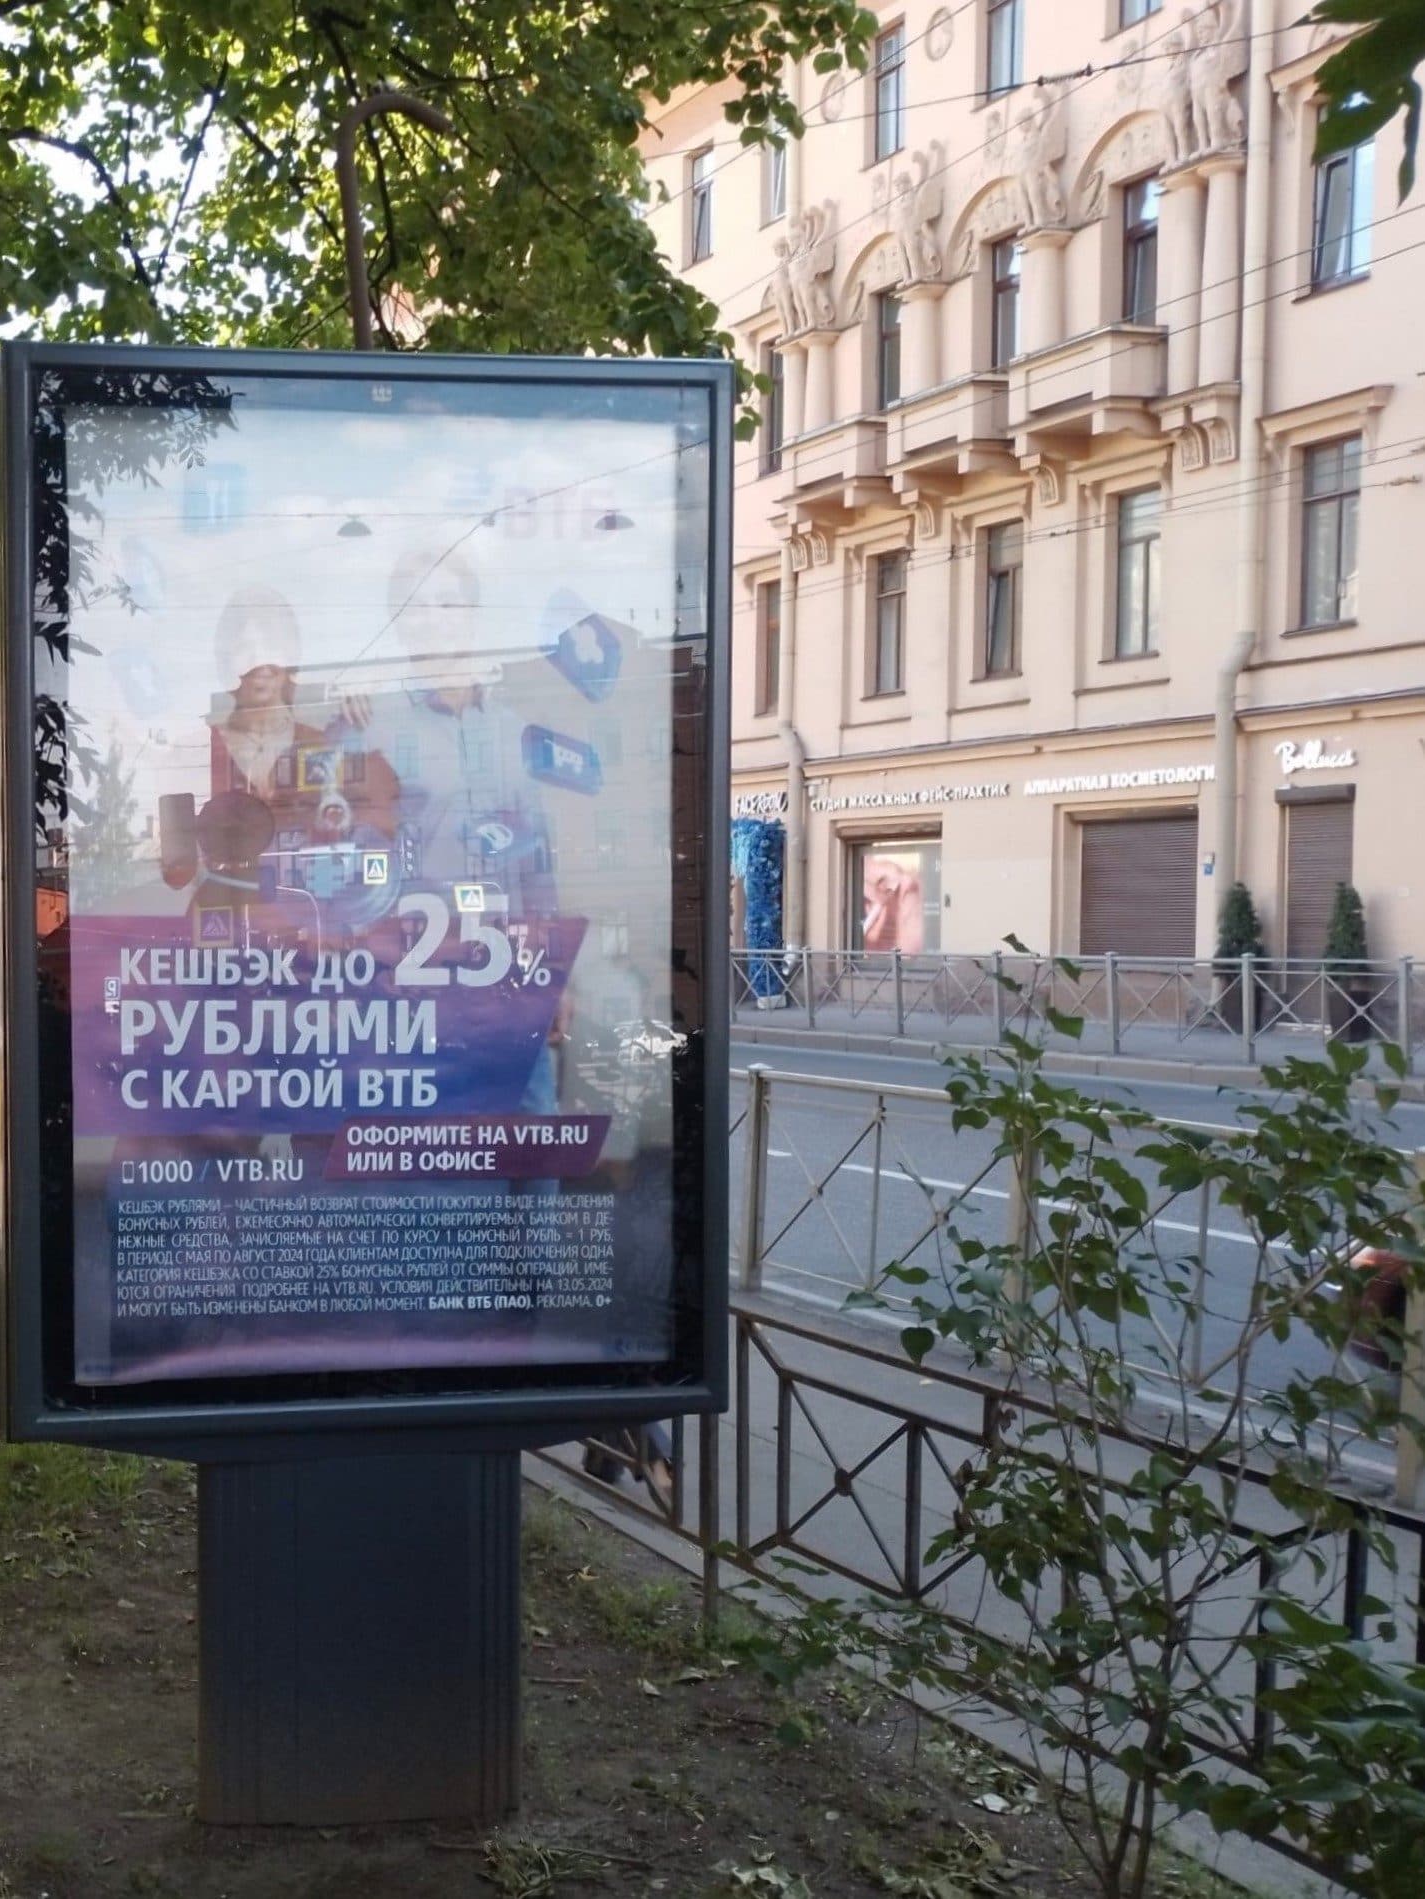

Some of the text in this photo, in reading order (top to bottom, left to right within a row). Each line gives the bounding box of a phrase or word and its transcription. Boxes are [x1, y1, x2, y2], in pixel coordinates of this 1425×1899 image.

[1024, 764, 1216, 795] АППАРАТНАЯ КОСМЕТОЛОГИ
[810, 784, 1009, 812] СТУДИЯ МАССАЖНЫХ ФЕЙС-ПРАКТИК
[120, 893, 551, 993] КЕШБЭК ДО 25%
[120, 1000, 437, 1056] РУБЛЯМИ
[121, 1059, 438, 1109] С КАРТОЙ ВТБ
[347, 1125, 589, 1146] ОФОРМИТЕ НА VTB.RU
[138, 1160, 193, 1184] 1000
[216, 1158, 304, 1181] VTB.RU
[347, 1151, 496, 1172] ИЛИ В ОФИСЕ
[118, 1200, 165, 1214] КЕШБЭК
[168, 1199, 221, 1213] РУБЛЯМИ
[236, 1195, 307, 1212] ЧАСТИЧНЫЙ
[310, 1197, 359, 1211] ВОЗВРАТ
[362, 1196, 433, 1209] СТОИМОСТИ
[436, 1195, 492, 1209] ПОКУПКИ
[495, 1195, 503, 1208] В
[505, 1195, 535, 1209] ВИДЕ
[538, 1194, 614, 1208] НАЧИСЛЕНИЯ
[118, 1217, 180, 1232] БОНУСНЫХ
[236, 1214, 313, 1229] ЕЖЕМЕСЯЧНО
[317, 1213, 415, 1228] АВТОМАТИЧЕСКИ
[421, 1212, 525, 1226] КОНВЕРТИРУЕМЫХ
[529, 1212, 578, 1225] БАНКОМ
[583, 1212, 591, 1225] В
[595, 1212, 614, 1227] ДЕ-
[118, 1234, 165, 1248] НЕЖНЫЕ
[240, 1231, 321, 1246] ЗАЧИСЛЯЕМЫЕ
[327, 1231, 343, 1245] НА
[382, 1230, 399, 1243] ПО
[404, 1230, 440, 1243] КУРСУ
[457, 1227, 520, 1242] БОНУСНЫЙ
[526, 1229, 560, 1242] РУБЛЬ
[590, 1229, 614, 1242] РУБ.
[118, 1245, 614, 1267] В ПЕРИОД С МАЯ ПО АВГУСТ 2024 ГОДА КЛИЕНТАМ ДОСТУПНА ДЛЯ ПОДКЛЮЧЕНИЯ ОДНА
[117, 1260, 613, 1283] КАТЕГОРИЯ КЕШБЭКА СО СТАВКОЙ 25% БОНУСНЫХ РУБЛЕЙ ОТ СУММЫ ОПЕРАЦИЙ. ИМЕ-
[117, 1285, 149, 1300] ЮТСЯ
[243, 1282, 309, 1297] ПОДРОБНЕЕ
[314, 1282, 330, 1296] НА
[381, 1280, 432, 1294] УСЛОВИЯ
[436, 1277, 532, 1293] ДЕЙСТВИТЕЛЬНЫ
[536, 1279, 553, 1292] НА
[557, 1278, 612, 1291] 13.05.2024
[117, 1303, 125, 1316] И
[129, 1302, 167, 1316] МОГУТ
[171, 1301, 200, 1315] БЫТЬ
[204, 1300, 266, 1314] ИЗМЕНЕНЫ
[269, 1299, 317, 1313] БАНКОМ
[320, 1299, 327, 1312] В
[329, 1296, 372, 1311] ЛЮБОЙ
[429, 1297, 464, 1309] БАНК
[468, 1296, 492, 1309] ВТБ
[494, 1295, 534, 1309] (ПАО).
[596, 1295, 612, 1308] 0+
